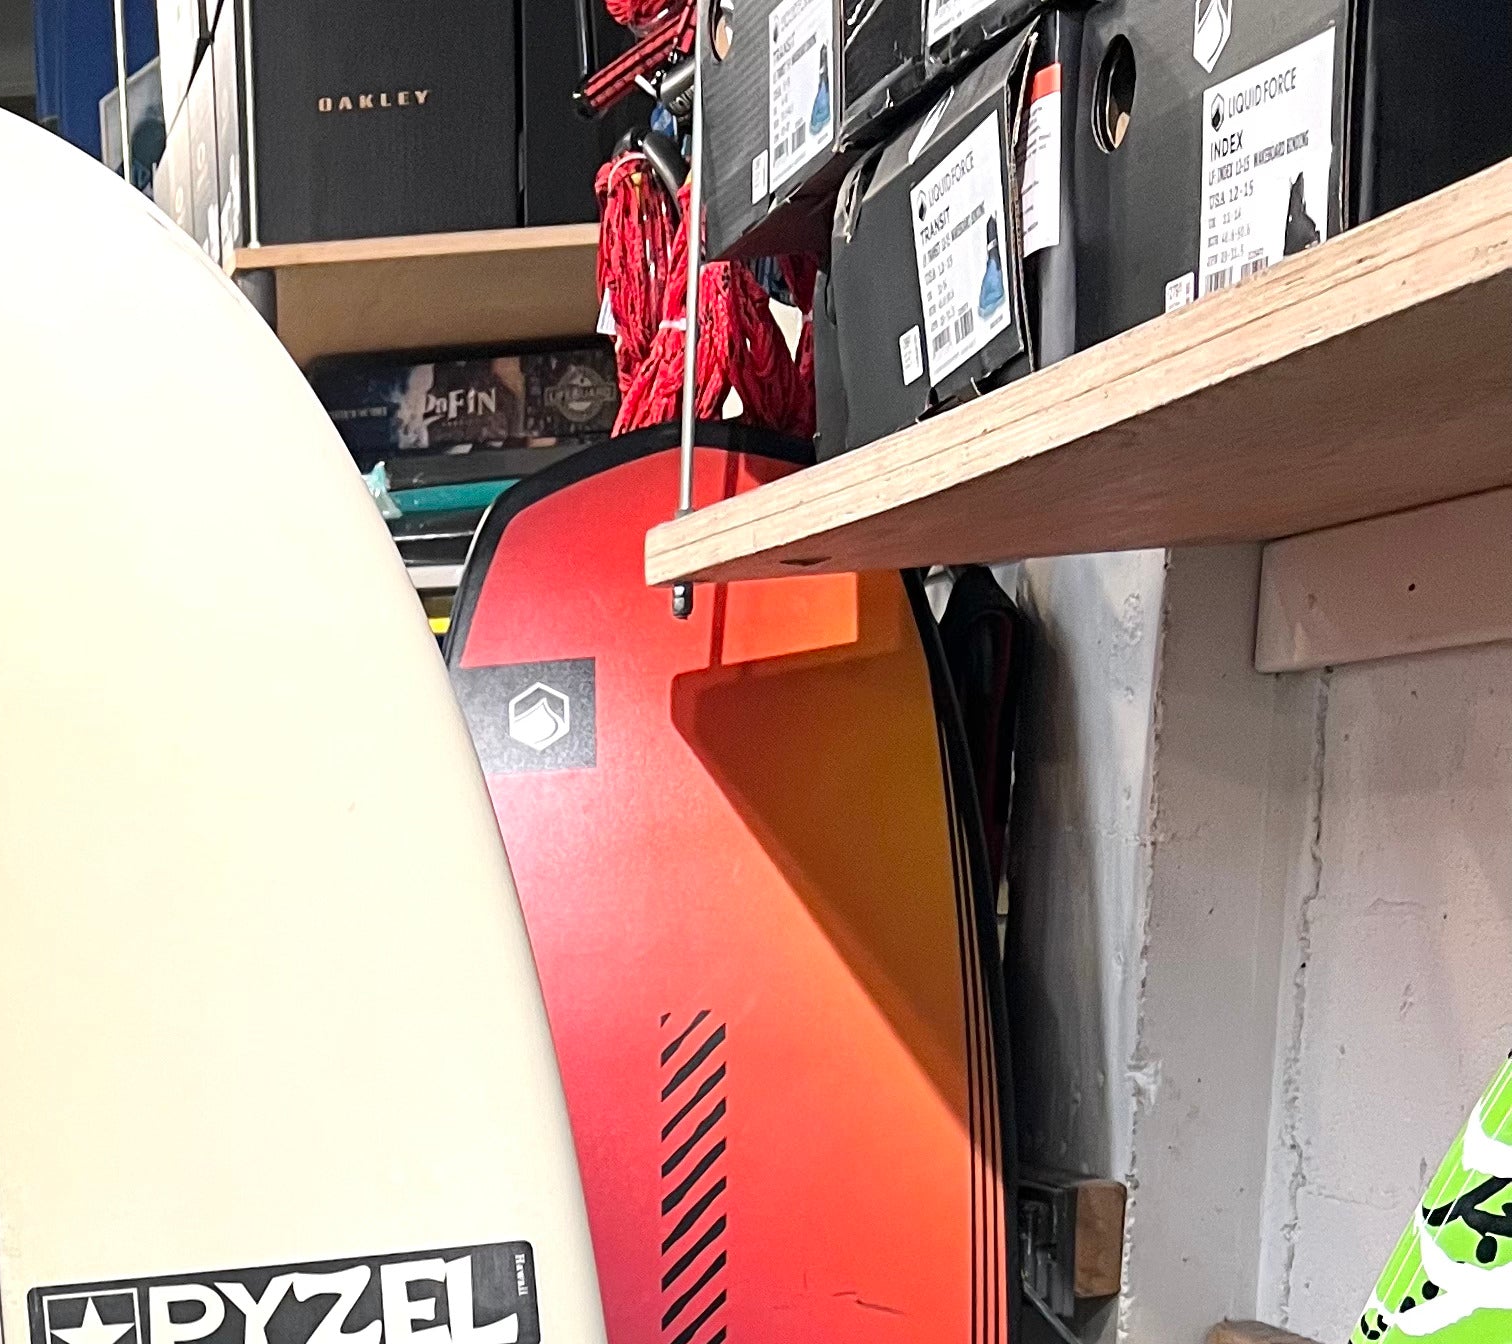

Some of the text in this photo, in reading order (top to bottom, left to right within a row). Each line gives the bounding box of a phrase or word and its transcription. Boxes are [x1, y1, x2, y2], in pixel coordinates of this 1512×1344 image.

[317, 89, 430, 113] OAKLEY
[1228, 66, 1297, 118] LIQUID FORCE
[1210, 128, 1244, 162] INDEX
[919, 205, 951, 247] TRANSIT
